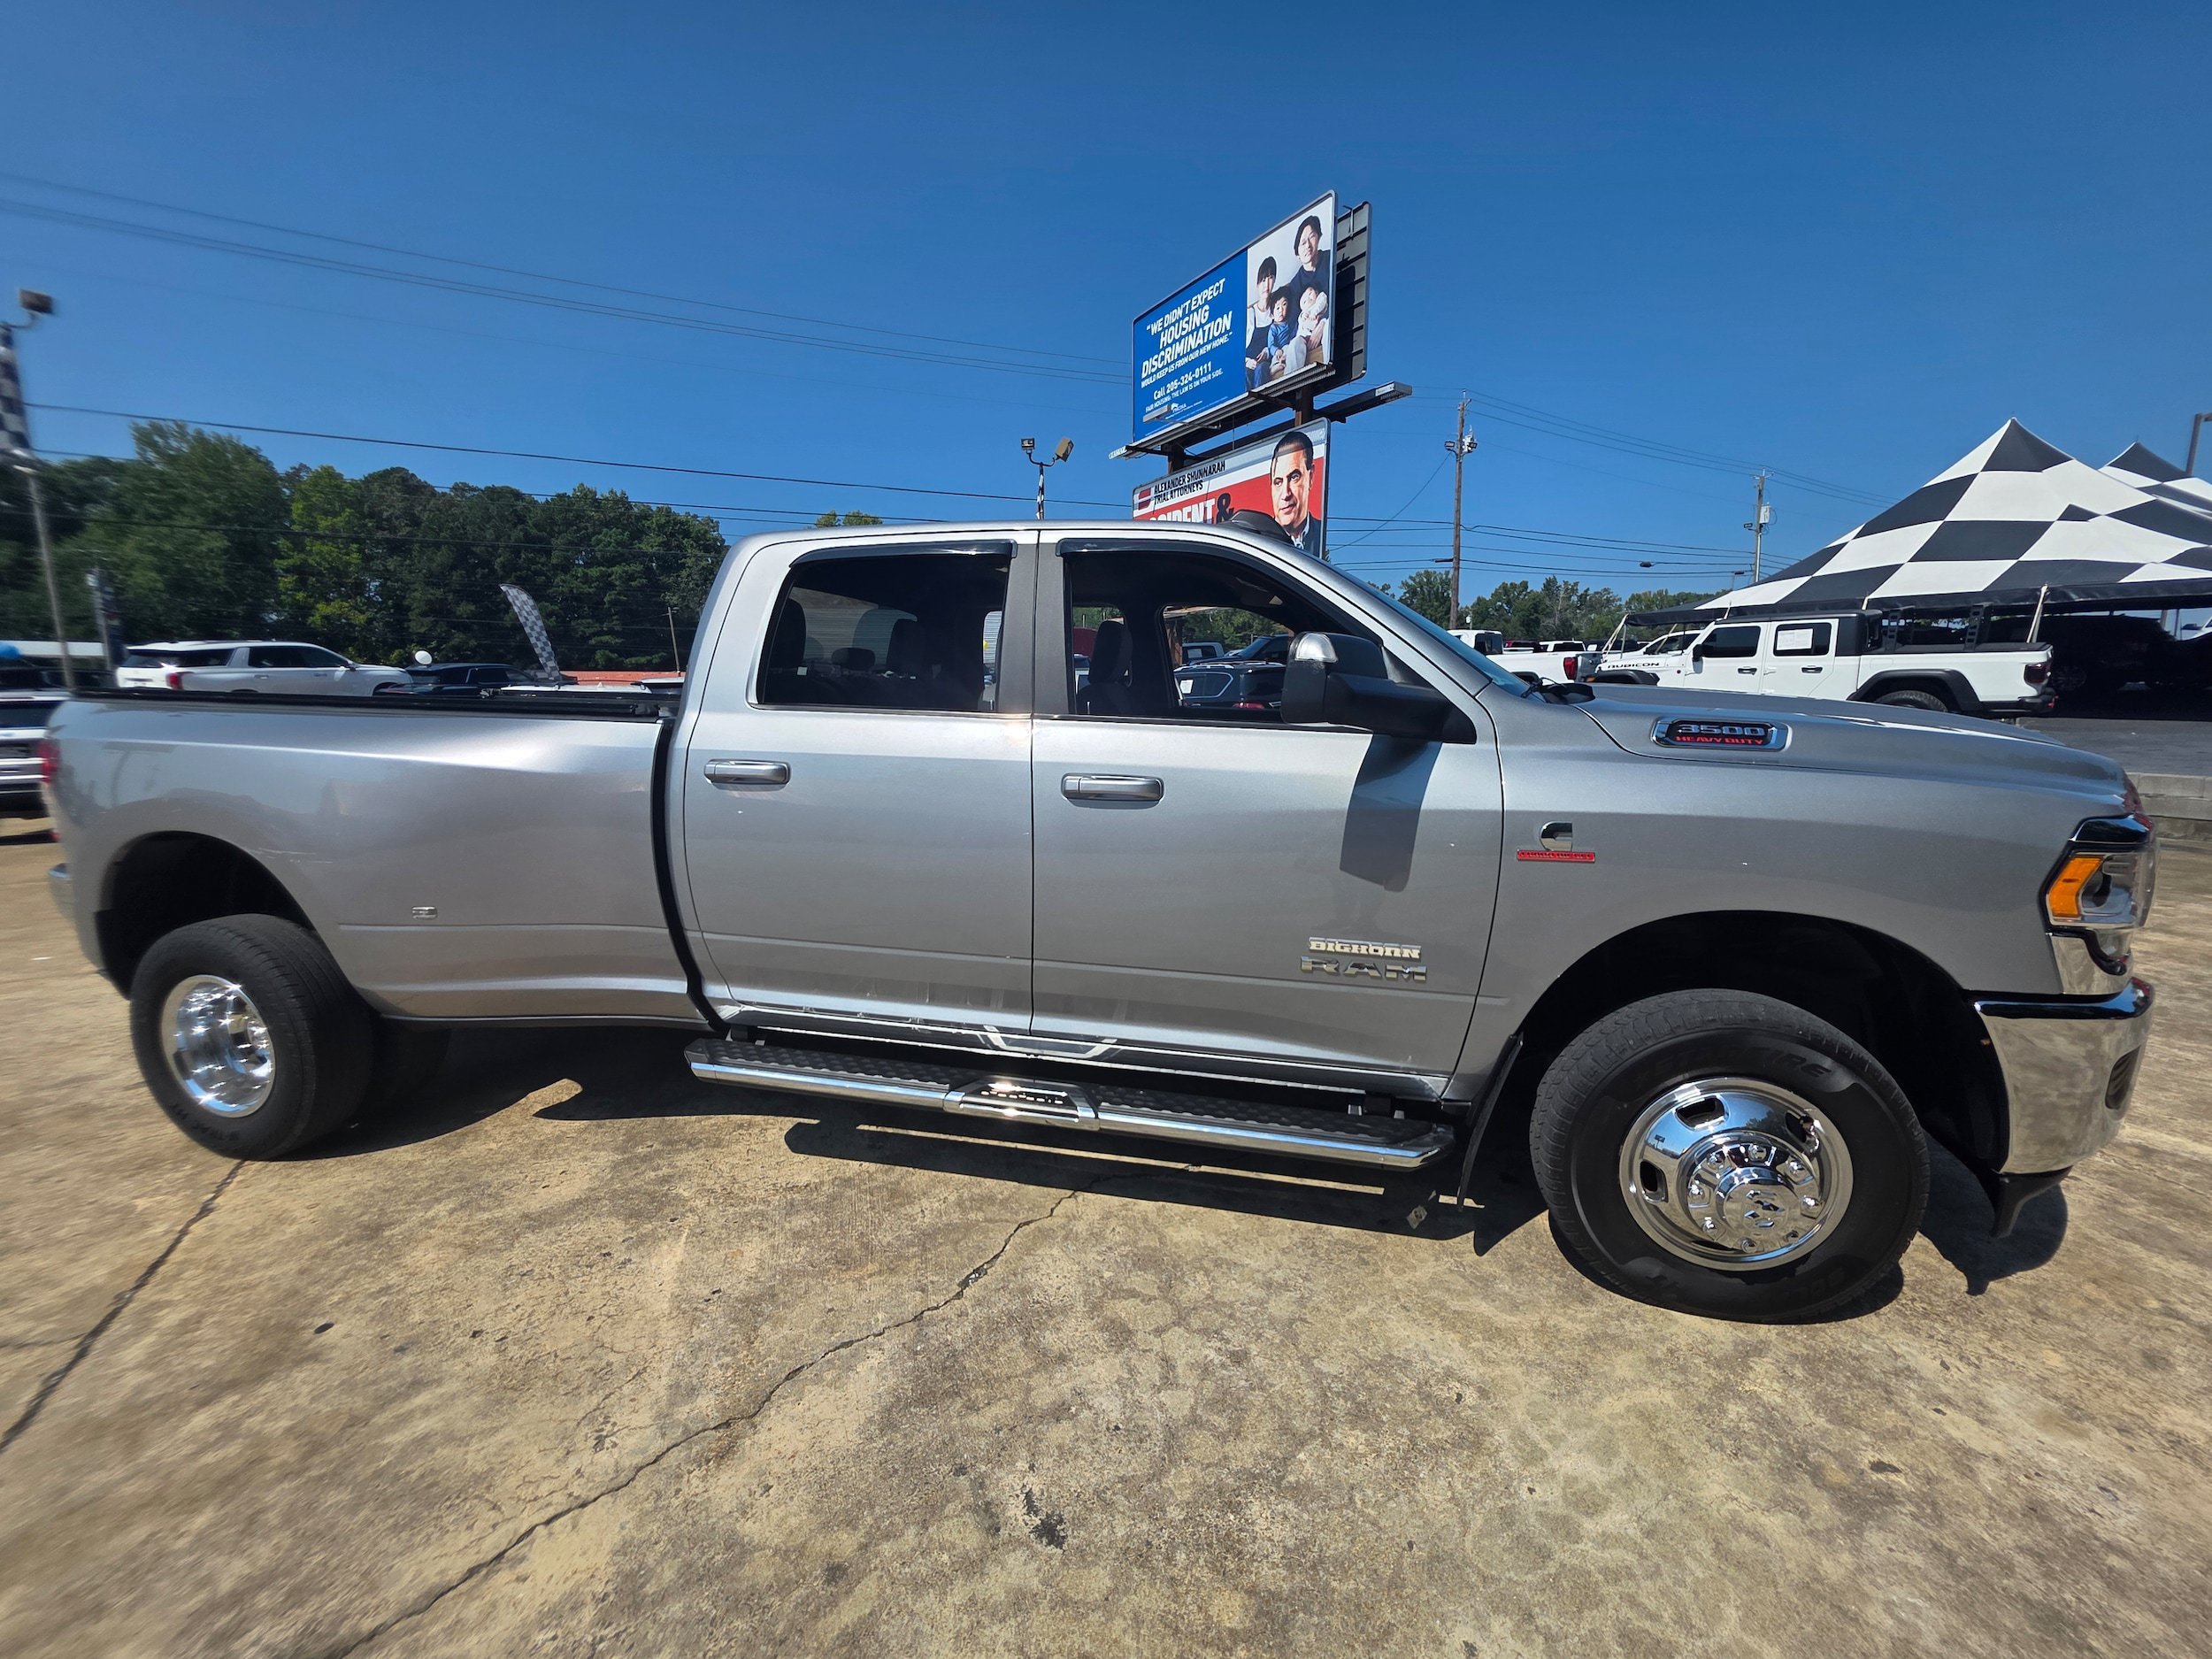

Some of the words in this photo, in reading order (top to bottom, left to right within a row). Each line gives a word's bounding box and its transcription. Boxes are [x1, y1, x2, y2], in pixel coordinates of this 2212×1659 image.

[1164, 299, 1191, 328] DIDN'T
[1191, 278, 1225, 311] EXPECT
[1160, 304, 1210, 349] HOUSING
[1141, 311, 1233, 379] DISCRIMINATION
[1141, 373, 1156, 388] WOULD
[1156, 367, 1169, 380] KEEP
[1168, 363, 1176, 373] US
[1175, 356, 1188, 369] FROM
[1188, 349, 1199, 361] OUR
[1199, 342, 1212, 356] NEW
[1154, 386, 1165, 400] Call
[1166, 361, 1211, 395] 205-324-0111
[1179, 385, 1188, 395] LAW
[1200, 373, 1211, 384] YOUR
[1154, 474, 1187, 495] ALEXANDER
[1187, 460, 1225, 482] SHUNNARAH
[1154, 492, 1169, 505] TRIAL
[1170, 480, 1203, 500] ATTORNEYS
[1675, 735, 1722, 744] HEAVY
[1724, 737, 1764, 746] DUTY
[1677, 723, 1766, 737] 3500
[1300, 956, 1428, 983] RAM
